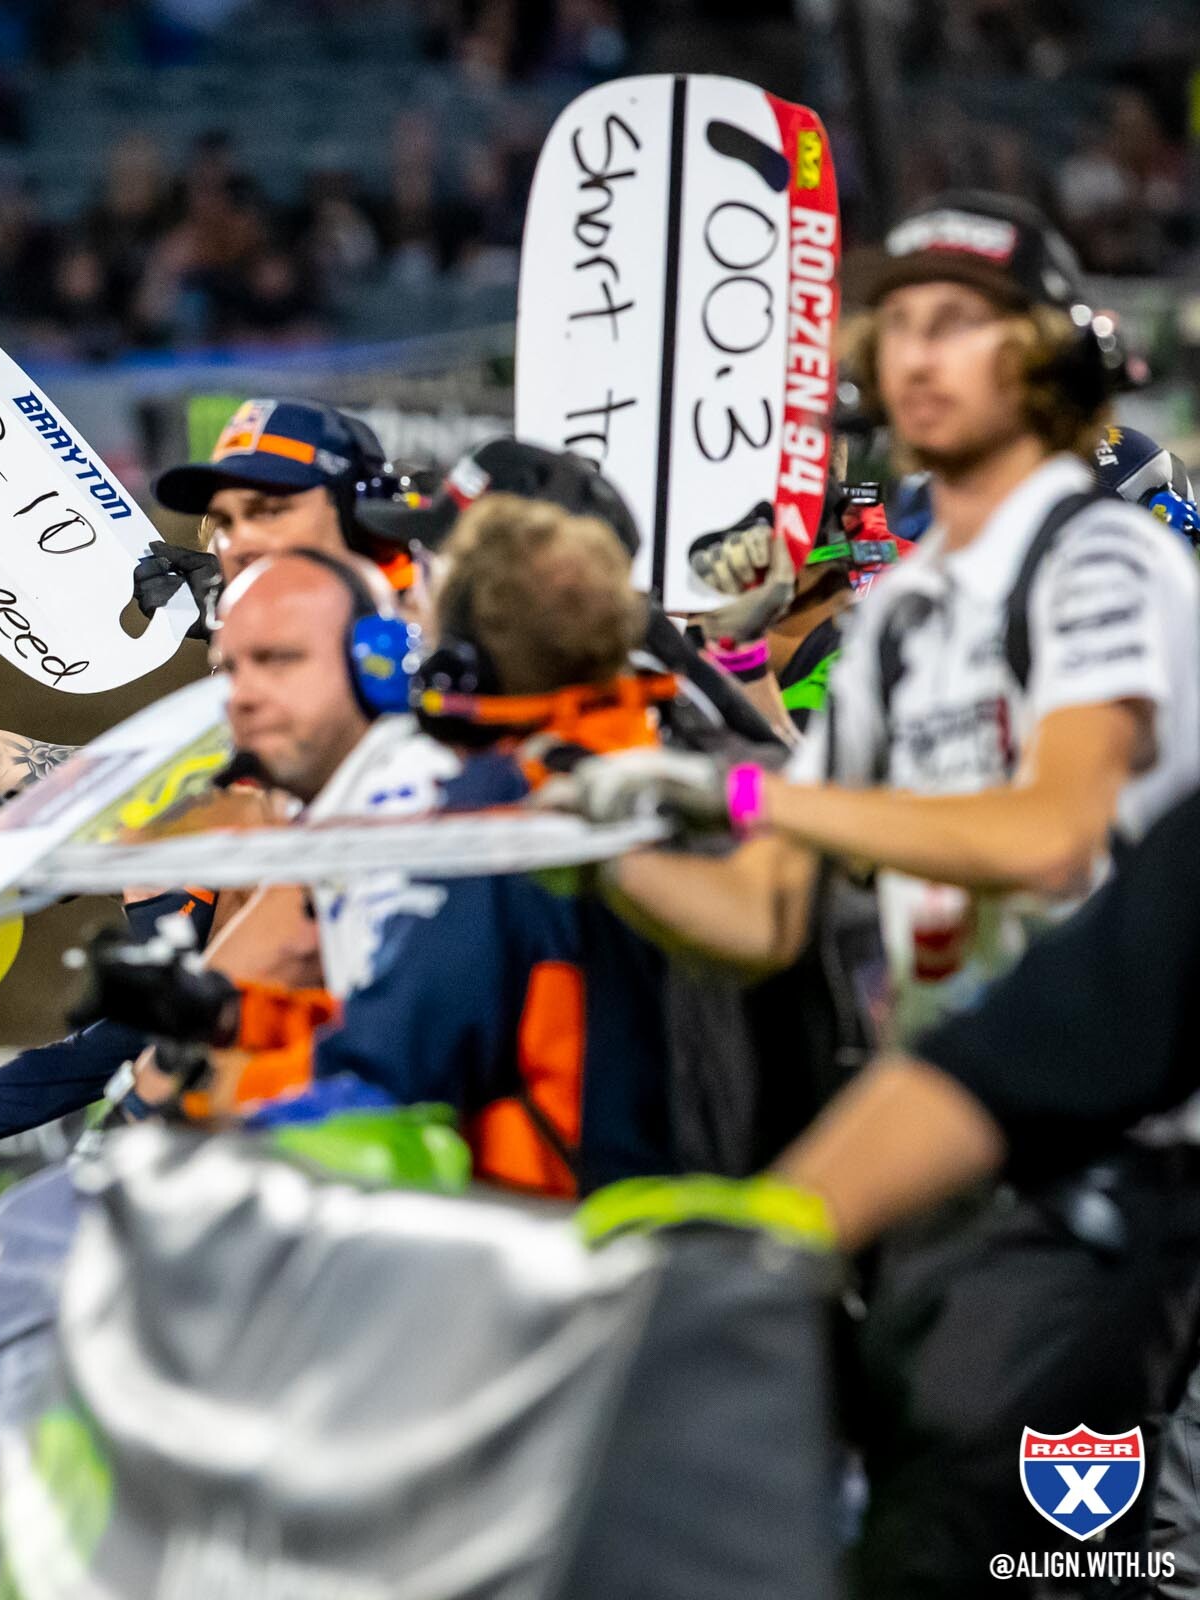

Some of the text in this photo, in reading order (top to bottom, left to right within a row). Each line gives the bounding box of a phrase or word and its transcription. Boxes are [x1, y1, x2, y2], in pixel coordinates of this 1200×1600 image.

[568, 113, 642, 341] Short
[12, 390, 133, 520] BRAYTON
[780, 206, 836, 495] ROCZEN 94
